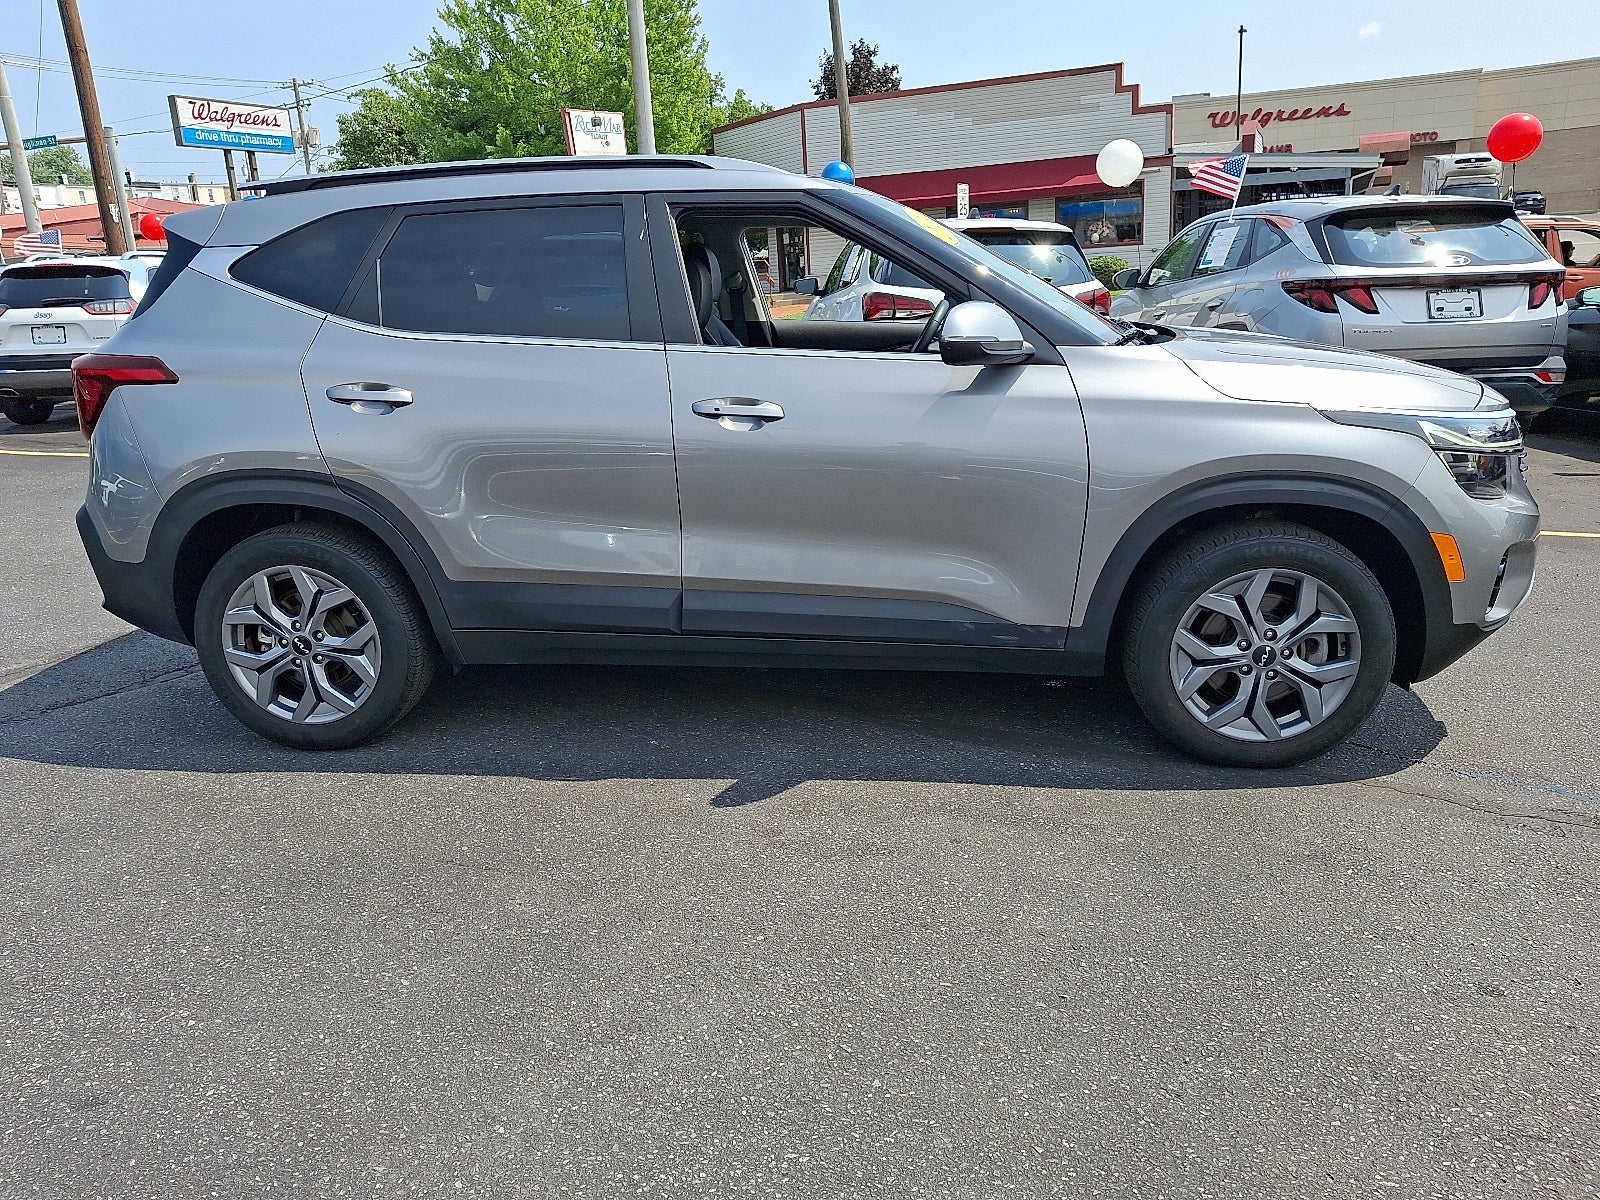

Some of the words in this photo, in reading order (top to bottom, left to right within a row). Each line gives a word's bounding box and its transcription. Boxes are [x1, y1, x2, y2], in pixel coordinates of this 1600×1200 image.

[188, 100, 281, 129] Walgreens
[1207, 102, 1352, 128] Walgreens
[195, 130, 219, 141] drive
[220, 131, 239, 143] thru
[240, 134, 282, 148] pharmacy
[1409, 131, 1439, 142] OTO
[959, 203, 968, 216] 25
